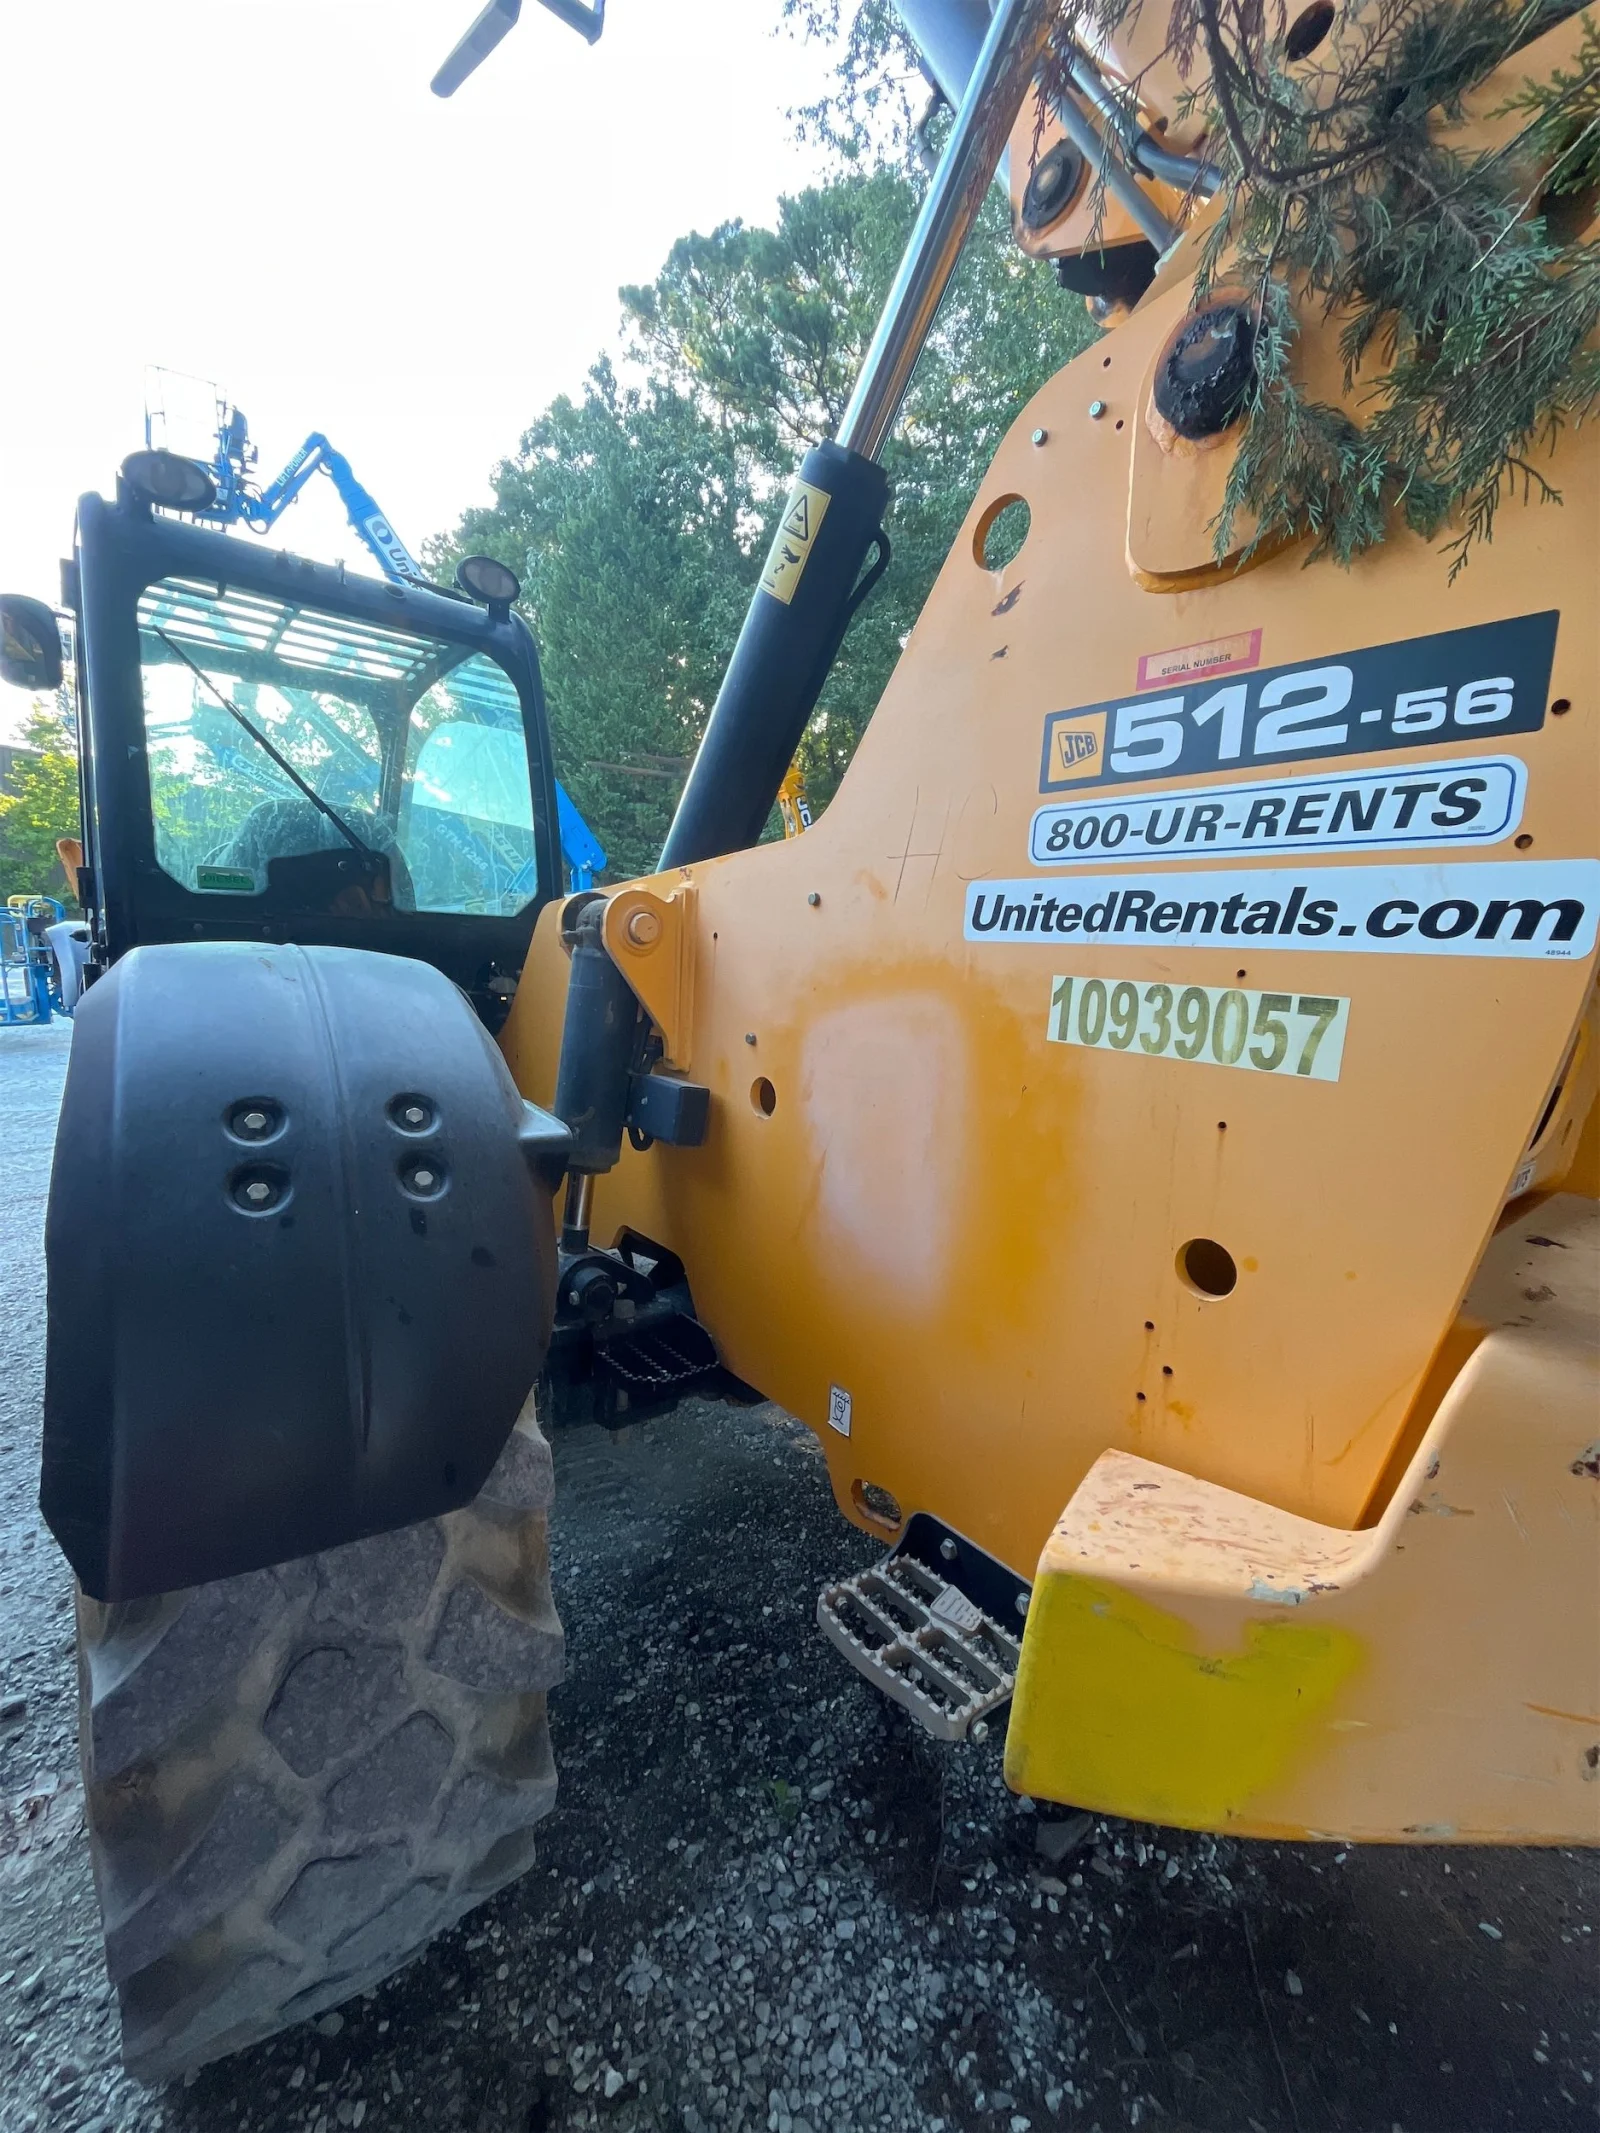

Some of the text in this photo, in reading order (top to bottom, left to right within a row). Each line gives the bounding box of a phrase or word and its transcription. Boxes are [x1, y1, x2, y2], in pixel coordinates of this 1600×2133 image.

[1161, 653, 1231, 675] SERIAL NUMBER
[1110, 665, 1514, 773] 512-56
[1064, 735, 1095, 765] JCB
[796, 796, 814, 832] JC
[1045, 778, 1488, 851] 800-UR-RENTS
[972, 886, 1585, 941] UnitedRentals.com
[1051, 976, 1340, 1075] 10939057
